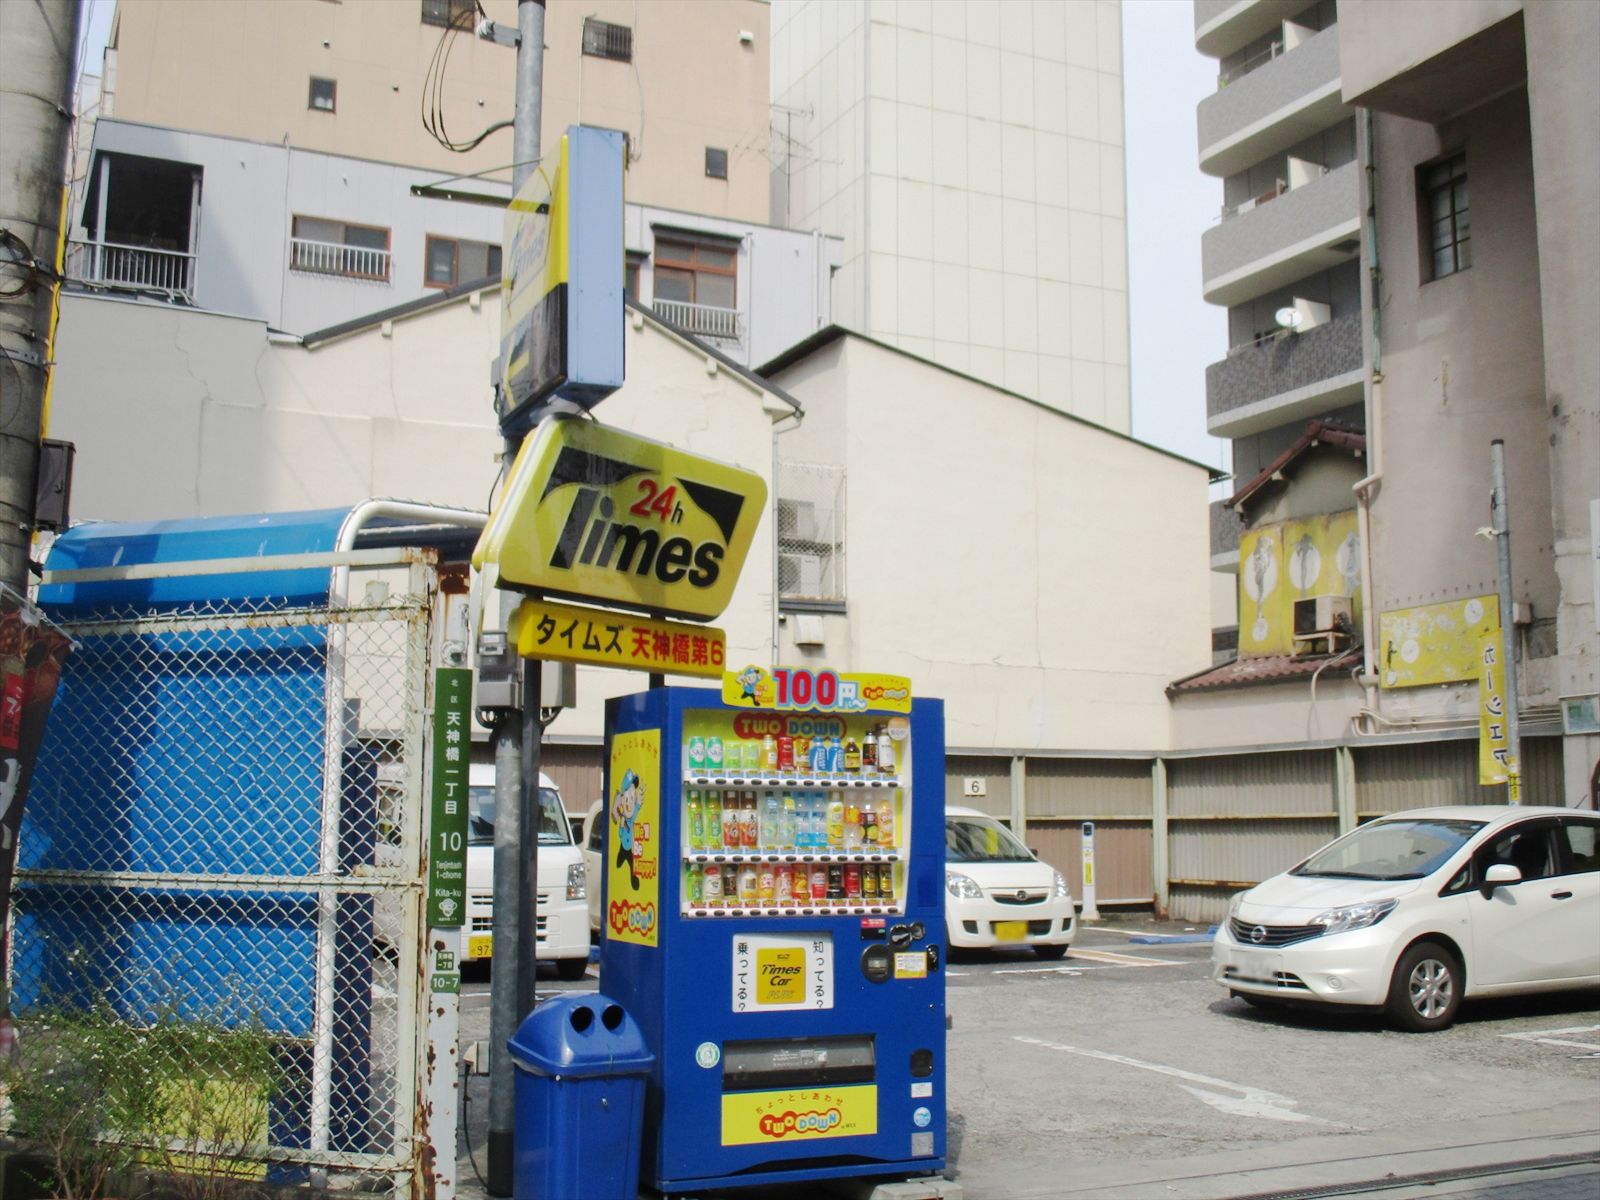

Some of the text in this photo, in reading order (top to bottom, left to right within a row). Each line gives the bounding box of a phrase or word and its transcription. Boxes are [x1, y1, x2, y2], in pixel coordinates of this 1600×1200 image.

[547, 484, 726, 589] Times
[537, 613, 724, 667] タイムズ 天神橋第6
[741, 718, 840, 735] TWO DOWN
[444, 711, 461, 815] 天神橋一丁目
[970, 780, 980, 793] 6
[439, 831, 461, 852] 10
[435, 888, 462, 897] Kita-ku
[762, 963, 802, 975] Times
[433, 977, 459, 989] 10-7
[769, 975, 792, 987] Car
[763, 1111, 839, 1135] TWO DOWN
